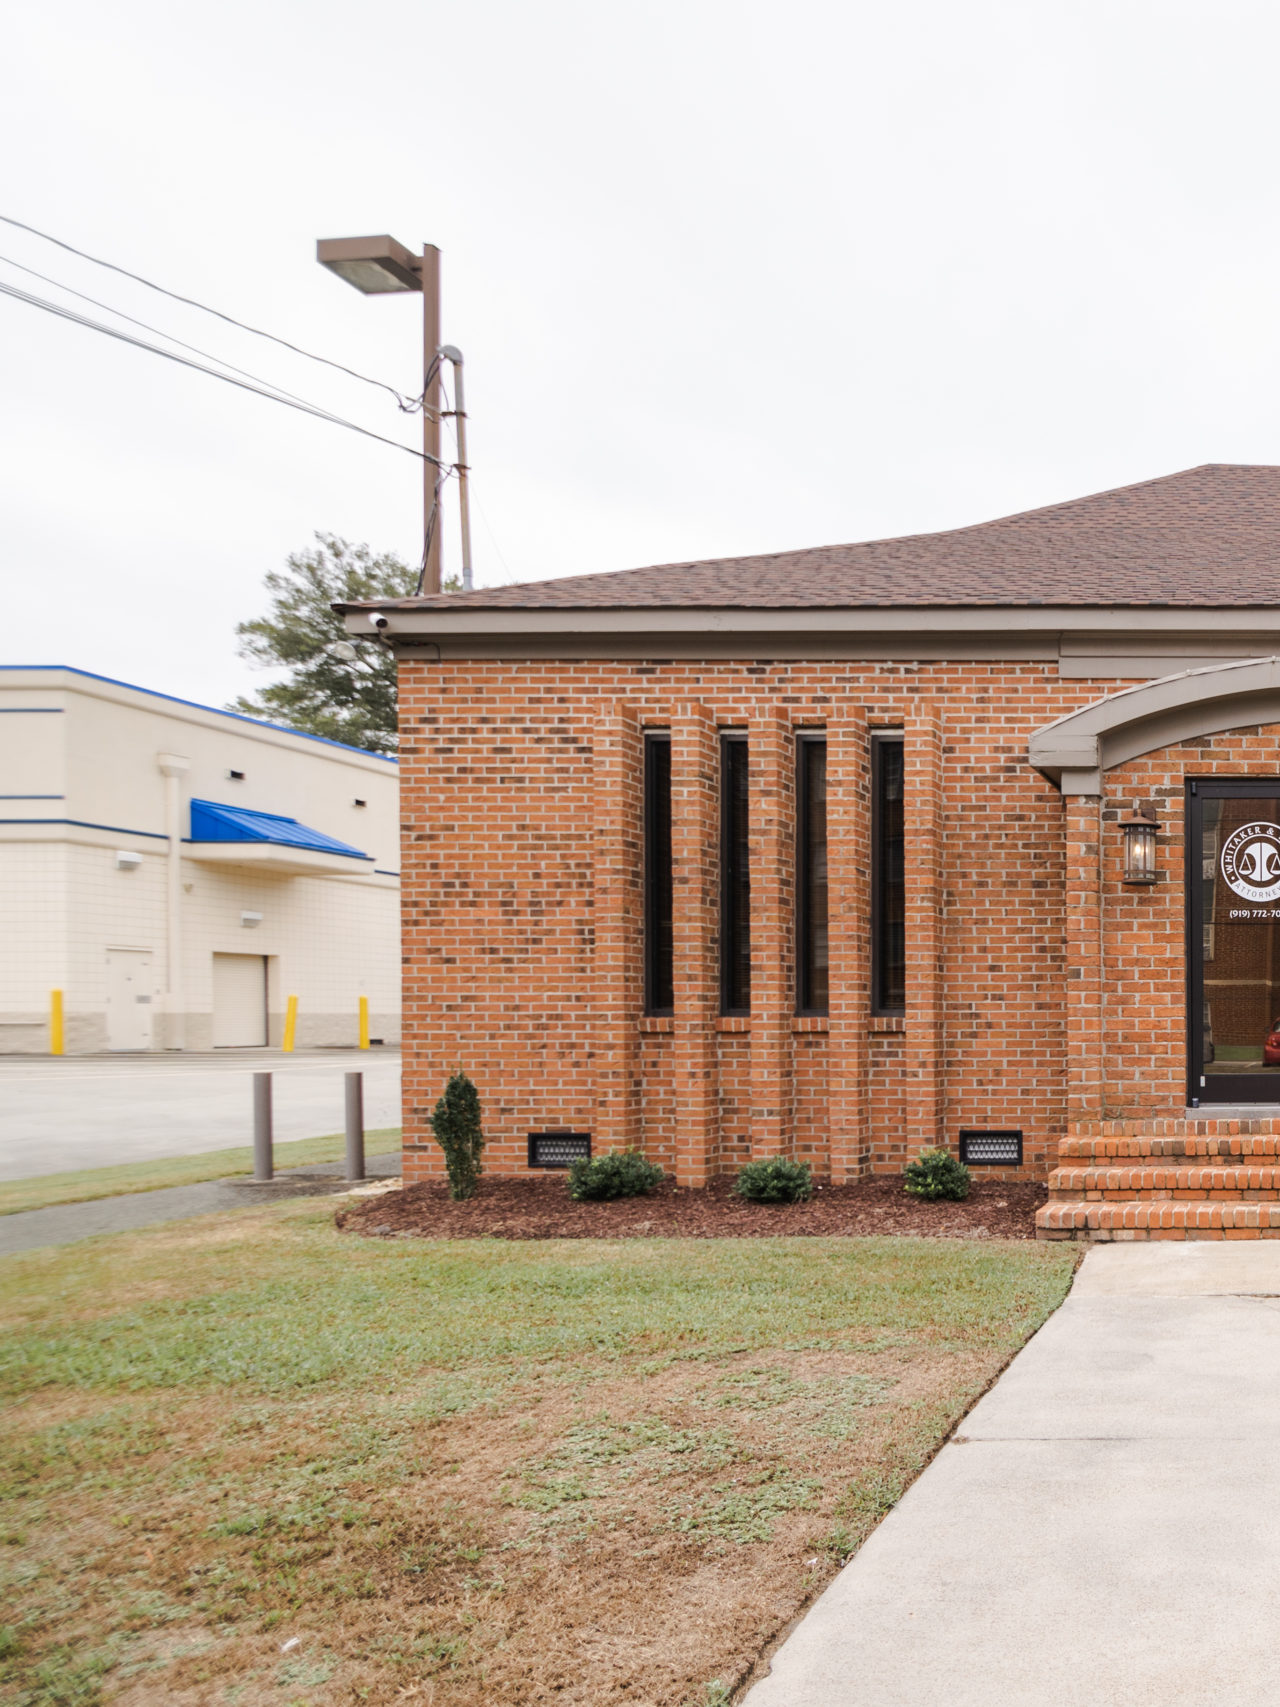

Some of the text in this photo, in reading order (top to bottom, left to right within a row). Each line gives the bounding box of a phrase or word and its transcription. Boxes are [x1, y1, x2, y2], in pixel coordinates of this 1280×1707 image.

[1224, 826, 1261, 874] WHITAKER
[1266, 827, 1275, 836] &
[1229, 909, 1251, 918] (919)
